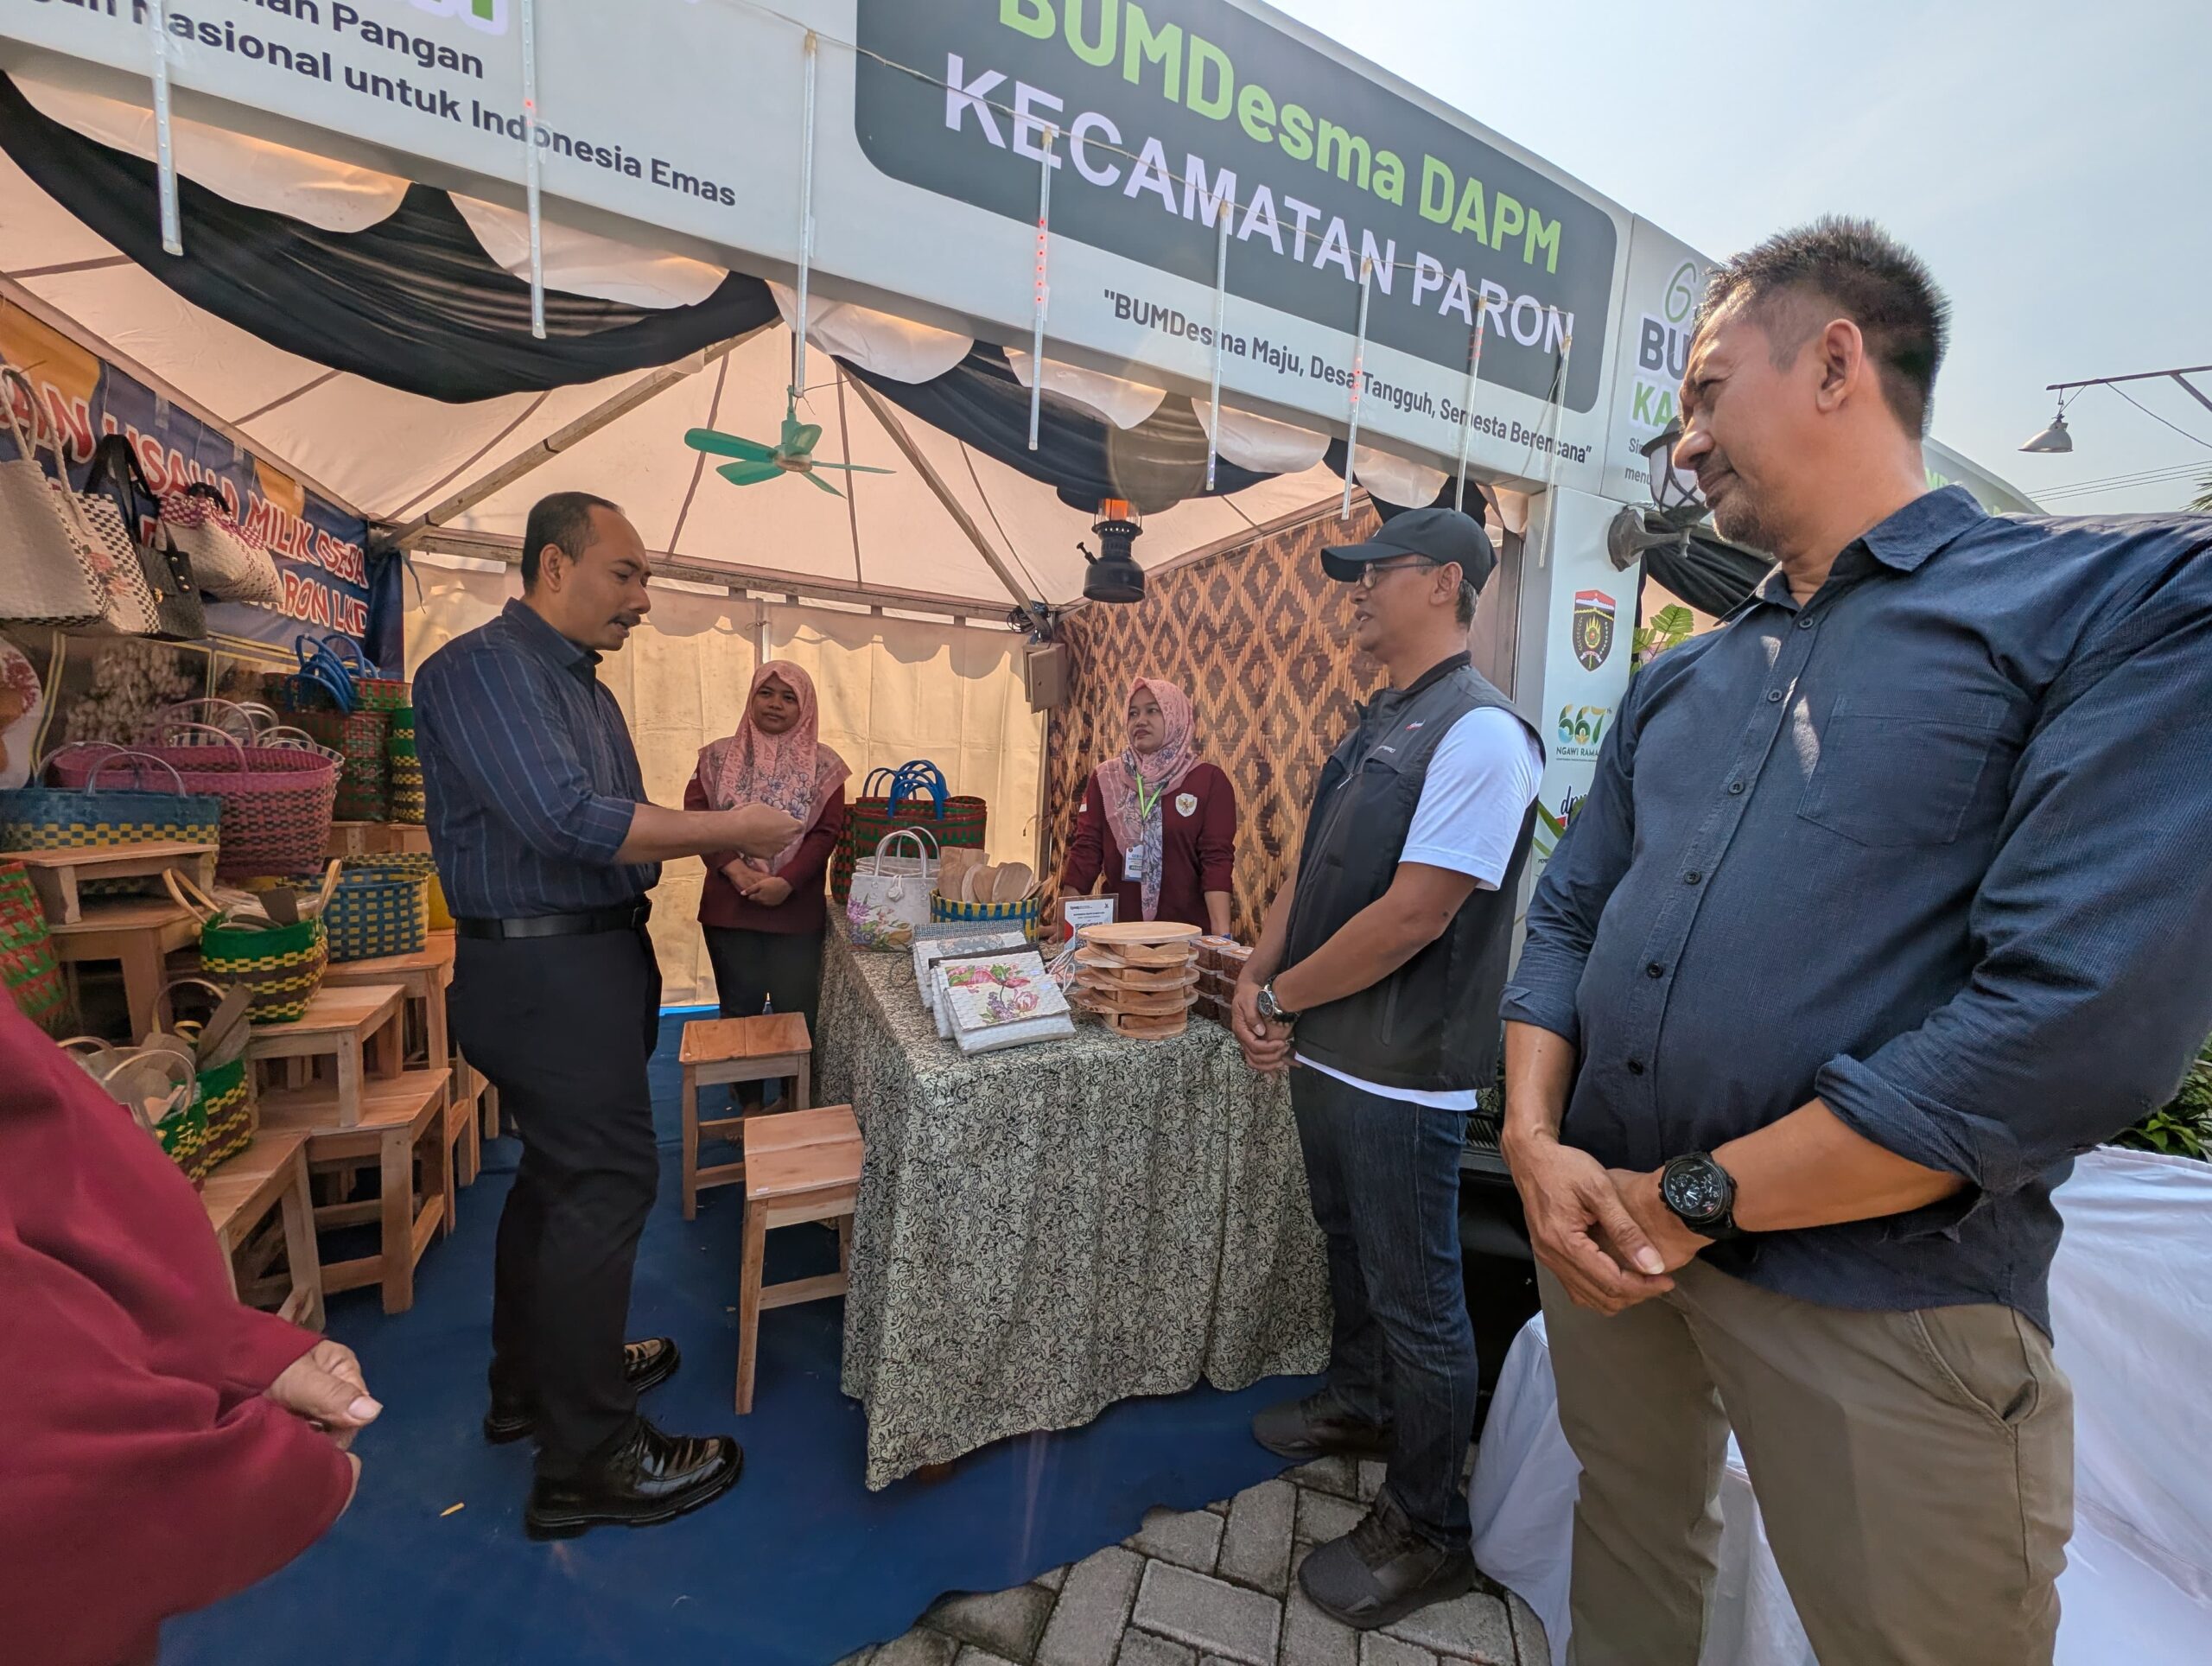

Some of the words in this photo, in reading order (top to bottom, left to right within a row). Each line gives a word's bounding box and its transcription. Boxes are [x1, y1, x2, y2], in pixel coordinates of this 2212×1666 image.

[333, 2, 483, 79] Pangan
[346, 67, 461, 123] untuk
[473, 100, 642, 179] Indonesia
[652, 158, 736, 207] Emas
[946, 53, 1396, 296] KECAMATAN
[1413, 251, 1574, 356] PARON
[1420, 154, 1561, 275] DAPM
[1252, 337, 1304, 377] Maju,
[1311, 355, 1355, 390] Desa
[1362, 372, 1436, 419] Tangguh,
[245, 490, 320, 567] MILIK
[315, 529, 369, 589] DESA
[1556, 747, 1579, 756] NGAWI
[1558, 704, 1606, 745] 667
